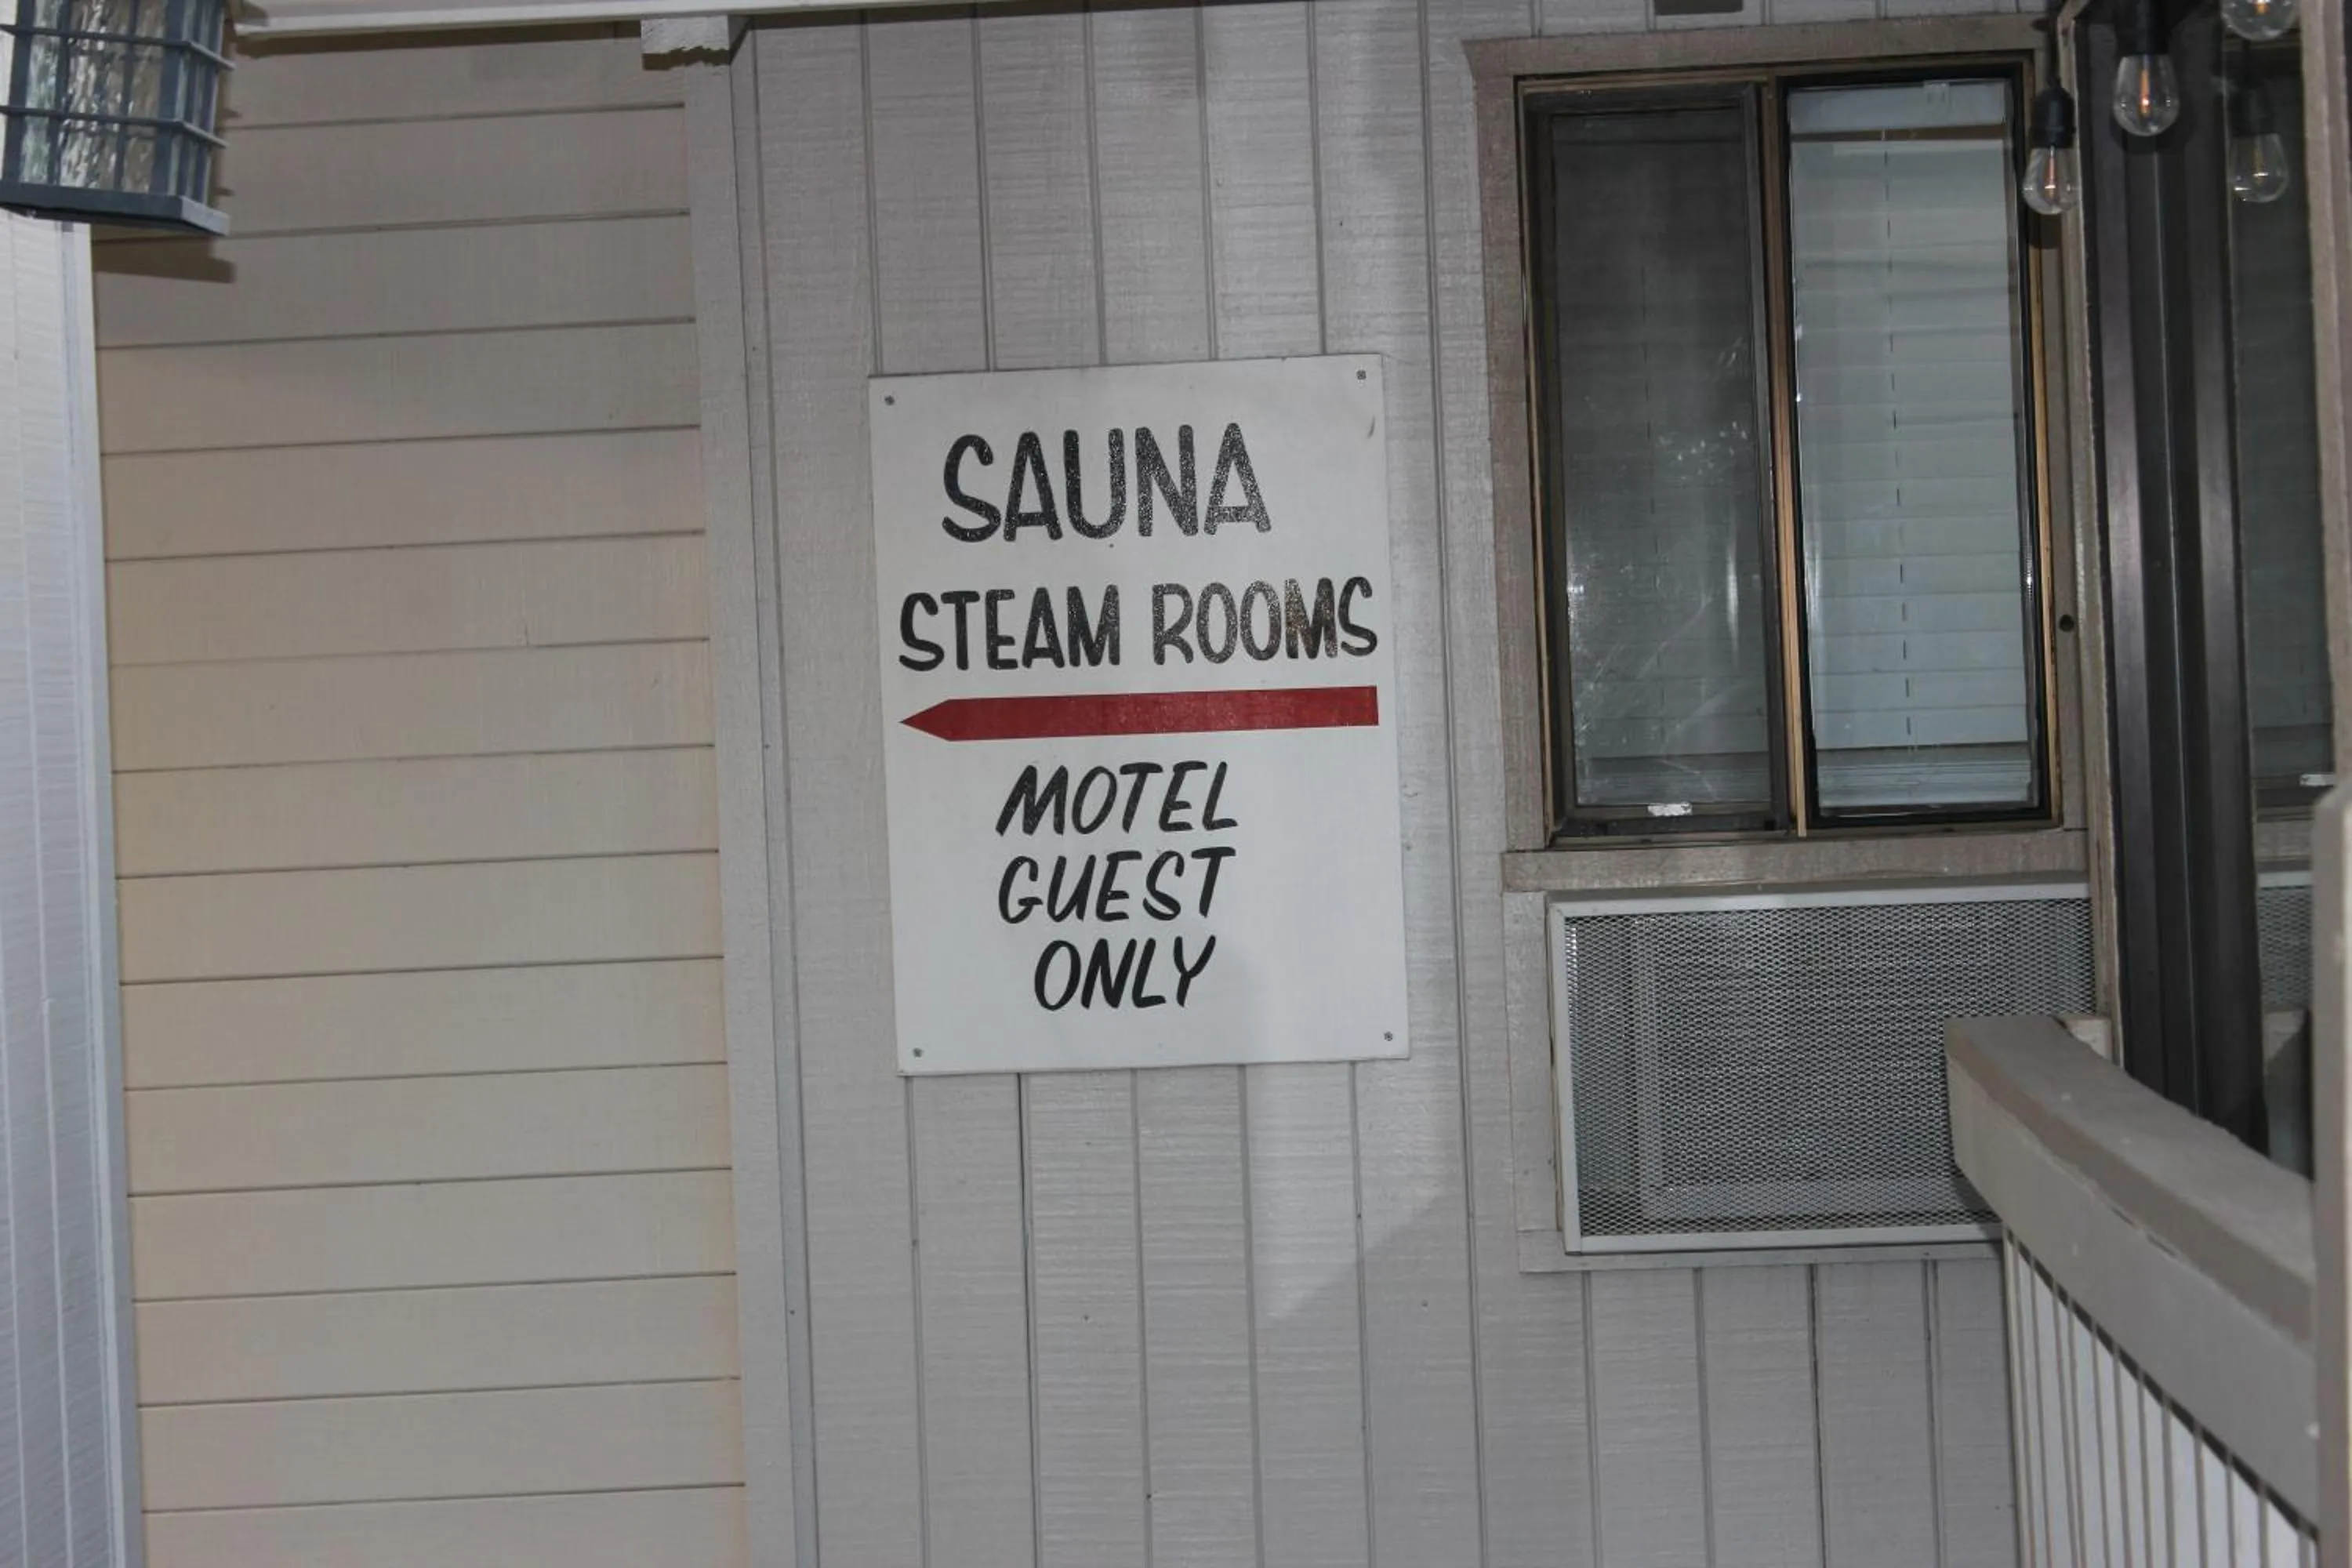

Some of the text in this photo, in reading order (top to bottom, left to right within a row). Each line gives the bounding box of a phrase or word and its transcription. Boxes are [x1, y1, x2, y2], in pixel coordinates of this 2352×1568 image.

[942, 423, 1271, 543] SAUNA
[899, 576, 1378, 671] STEAM ROOMS
[995, 760, 1237, 837] MOTEL
[998, 846, 1236, 924] GUEST
[1035, 935, 1217, 1011] ONLY
